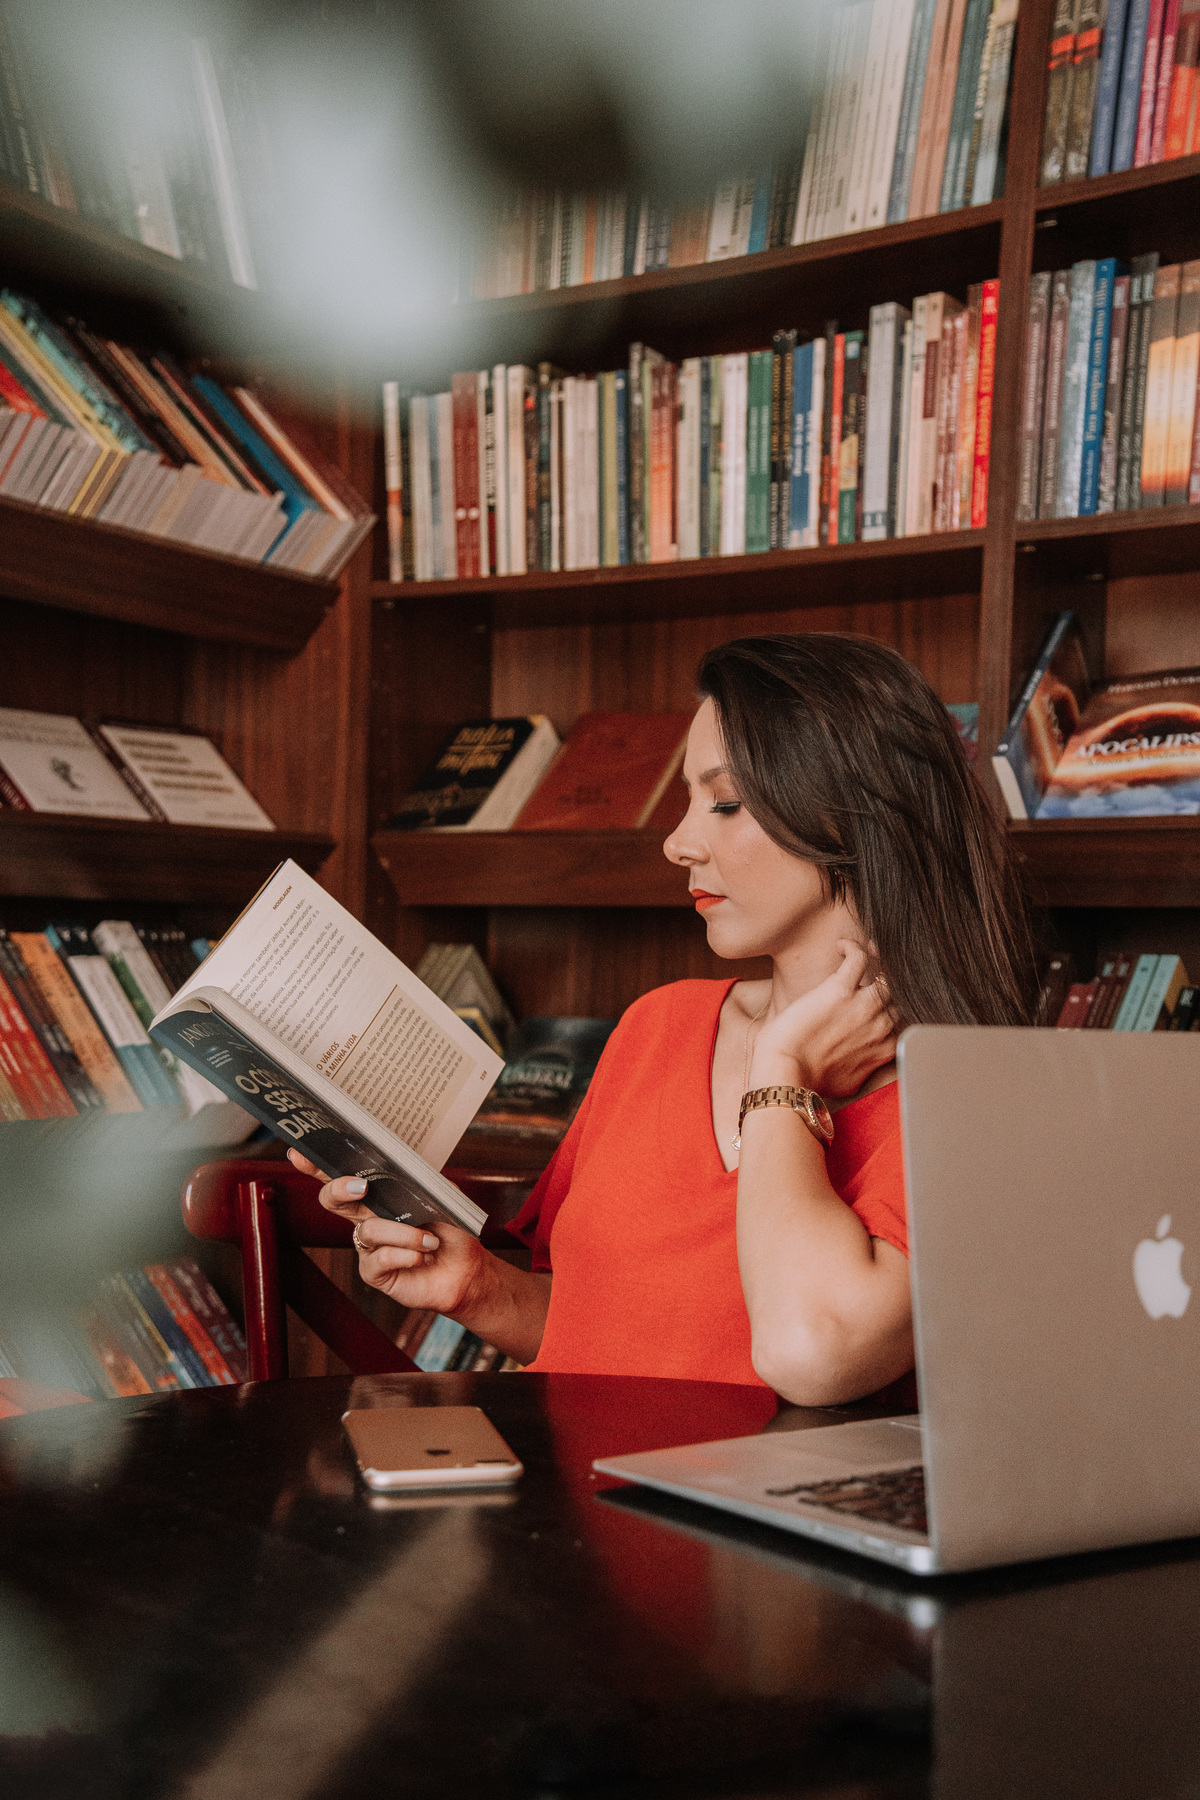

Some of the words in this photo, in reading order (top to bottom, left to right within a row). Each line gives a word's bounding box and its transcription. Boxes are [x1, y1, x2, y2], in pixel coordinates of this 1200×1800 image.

[272, 885, 292, 910] MODELAGEM
[319, 1041, 339, 1064] VÁRIOS
[328, 1048, 347, 1071] MINHA
[343, 1033, 358, 1049] VIDA
[235, 1074, 261, 1094] O
[277, 1113, 311, 1140] DA
